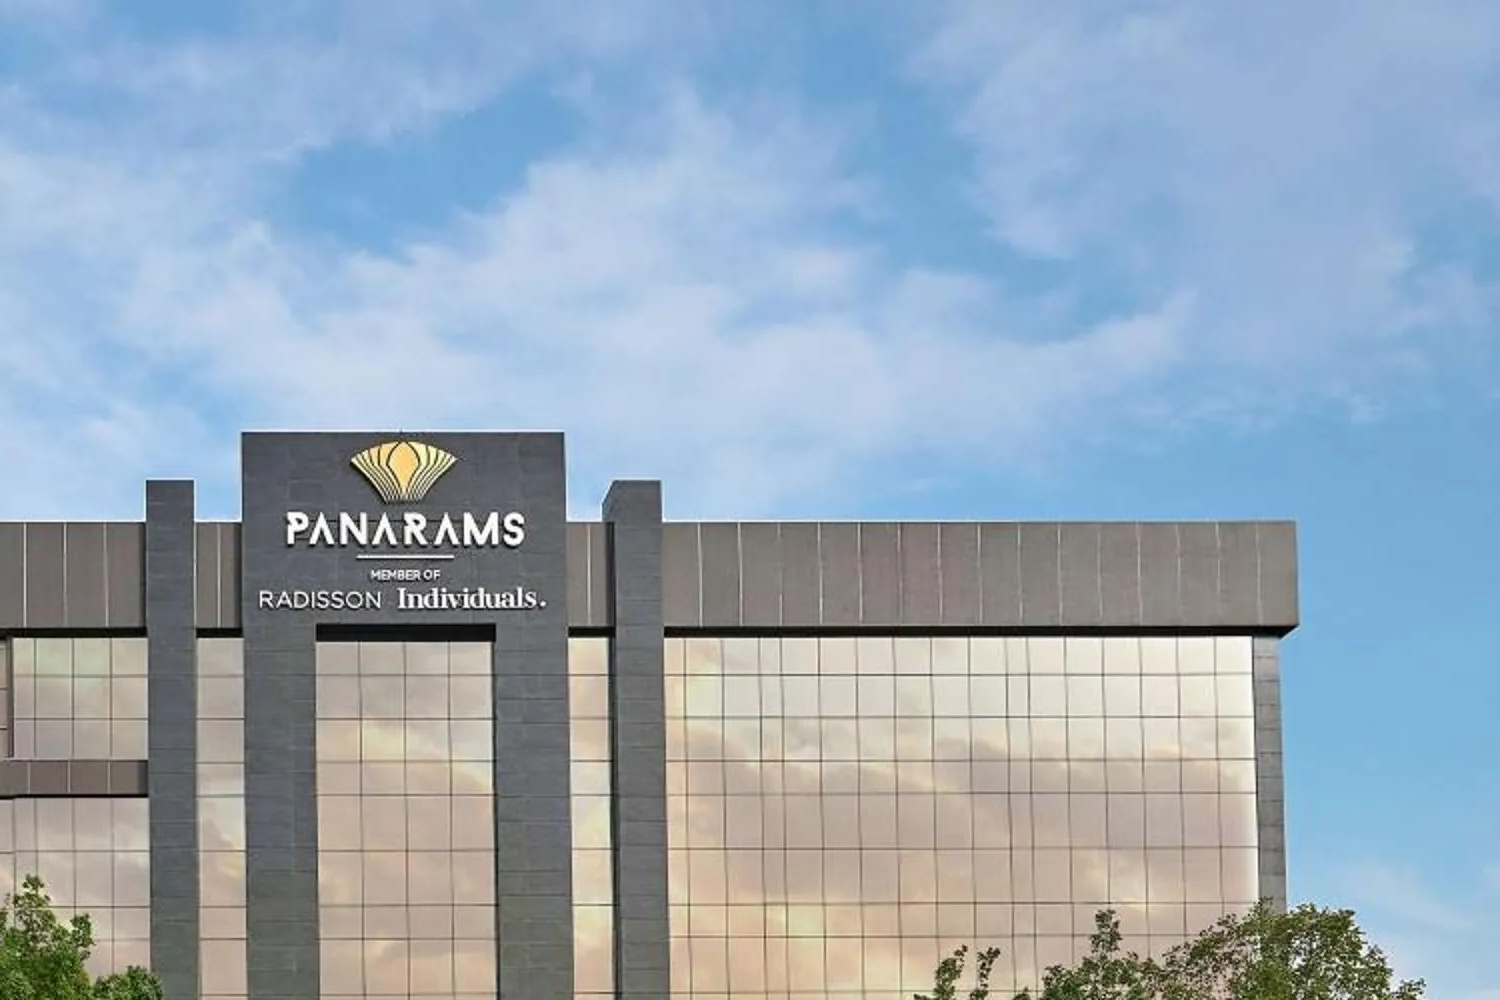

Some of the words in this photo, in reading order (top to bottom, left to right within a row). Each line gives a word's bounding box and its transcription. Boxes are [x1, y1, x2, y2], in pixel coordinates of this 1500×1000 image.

[286, 511, 526, 546] PANARAMS
[370, 569, 419, 581] MEMBER
[422, 569, 442, 581] OF
[259, 590, 382, 609] RADISSON
[396, 586, 547, 610] Individuals.
